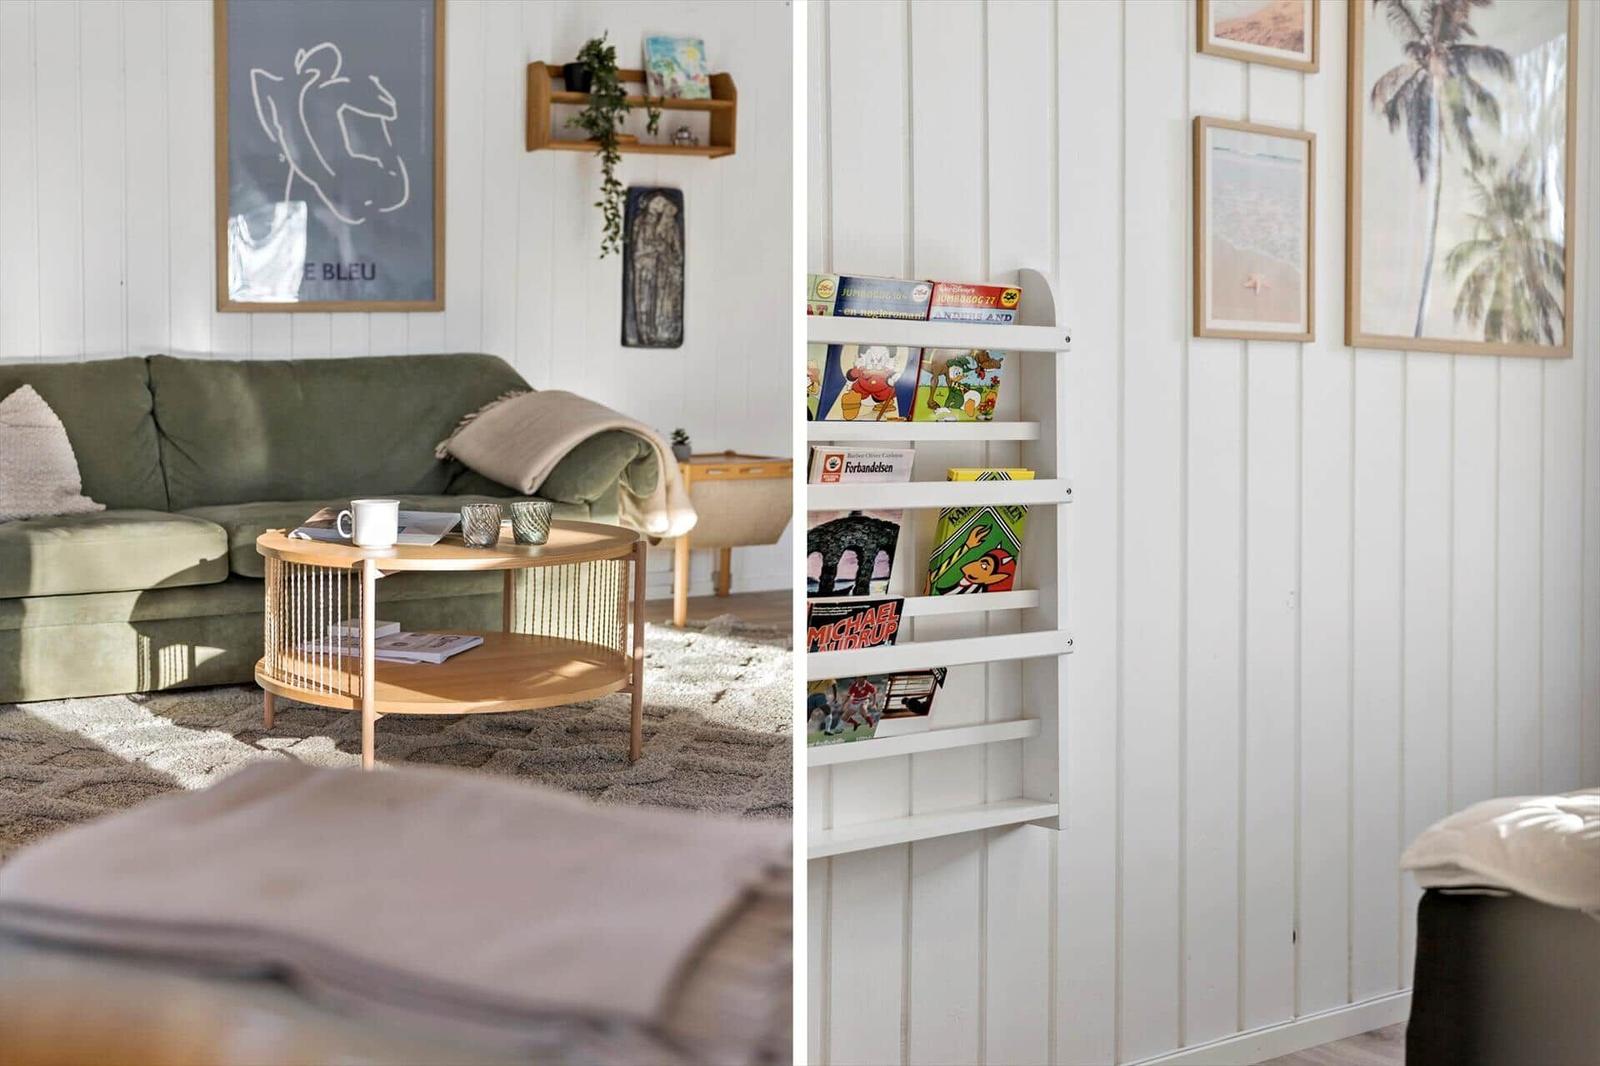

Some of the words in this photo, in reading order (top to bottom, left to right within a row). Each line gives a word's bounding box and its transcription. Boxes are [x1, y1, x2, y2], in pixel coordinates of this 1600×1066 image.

[304, 263, 316, 281] E
[322, 262, 376, 281] BLEU
[936, 294, 983, 305] JUMBOBOG
[985, 296, 997, 305] 77
[933, 309, 983, 321] ANDERS
[986, 313, 1013, 323] AND
[844, 461, 894, 474] Forbandelsen
[807, 602, 899, 650] MICHAEL
